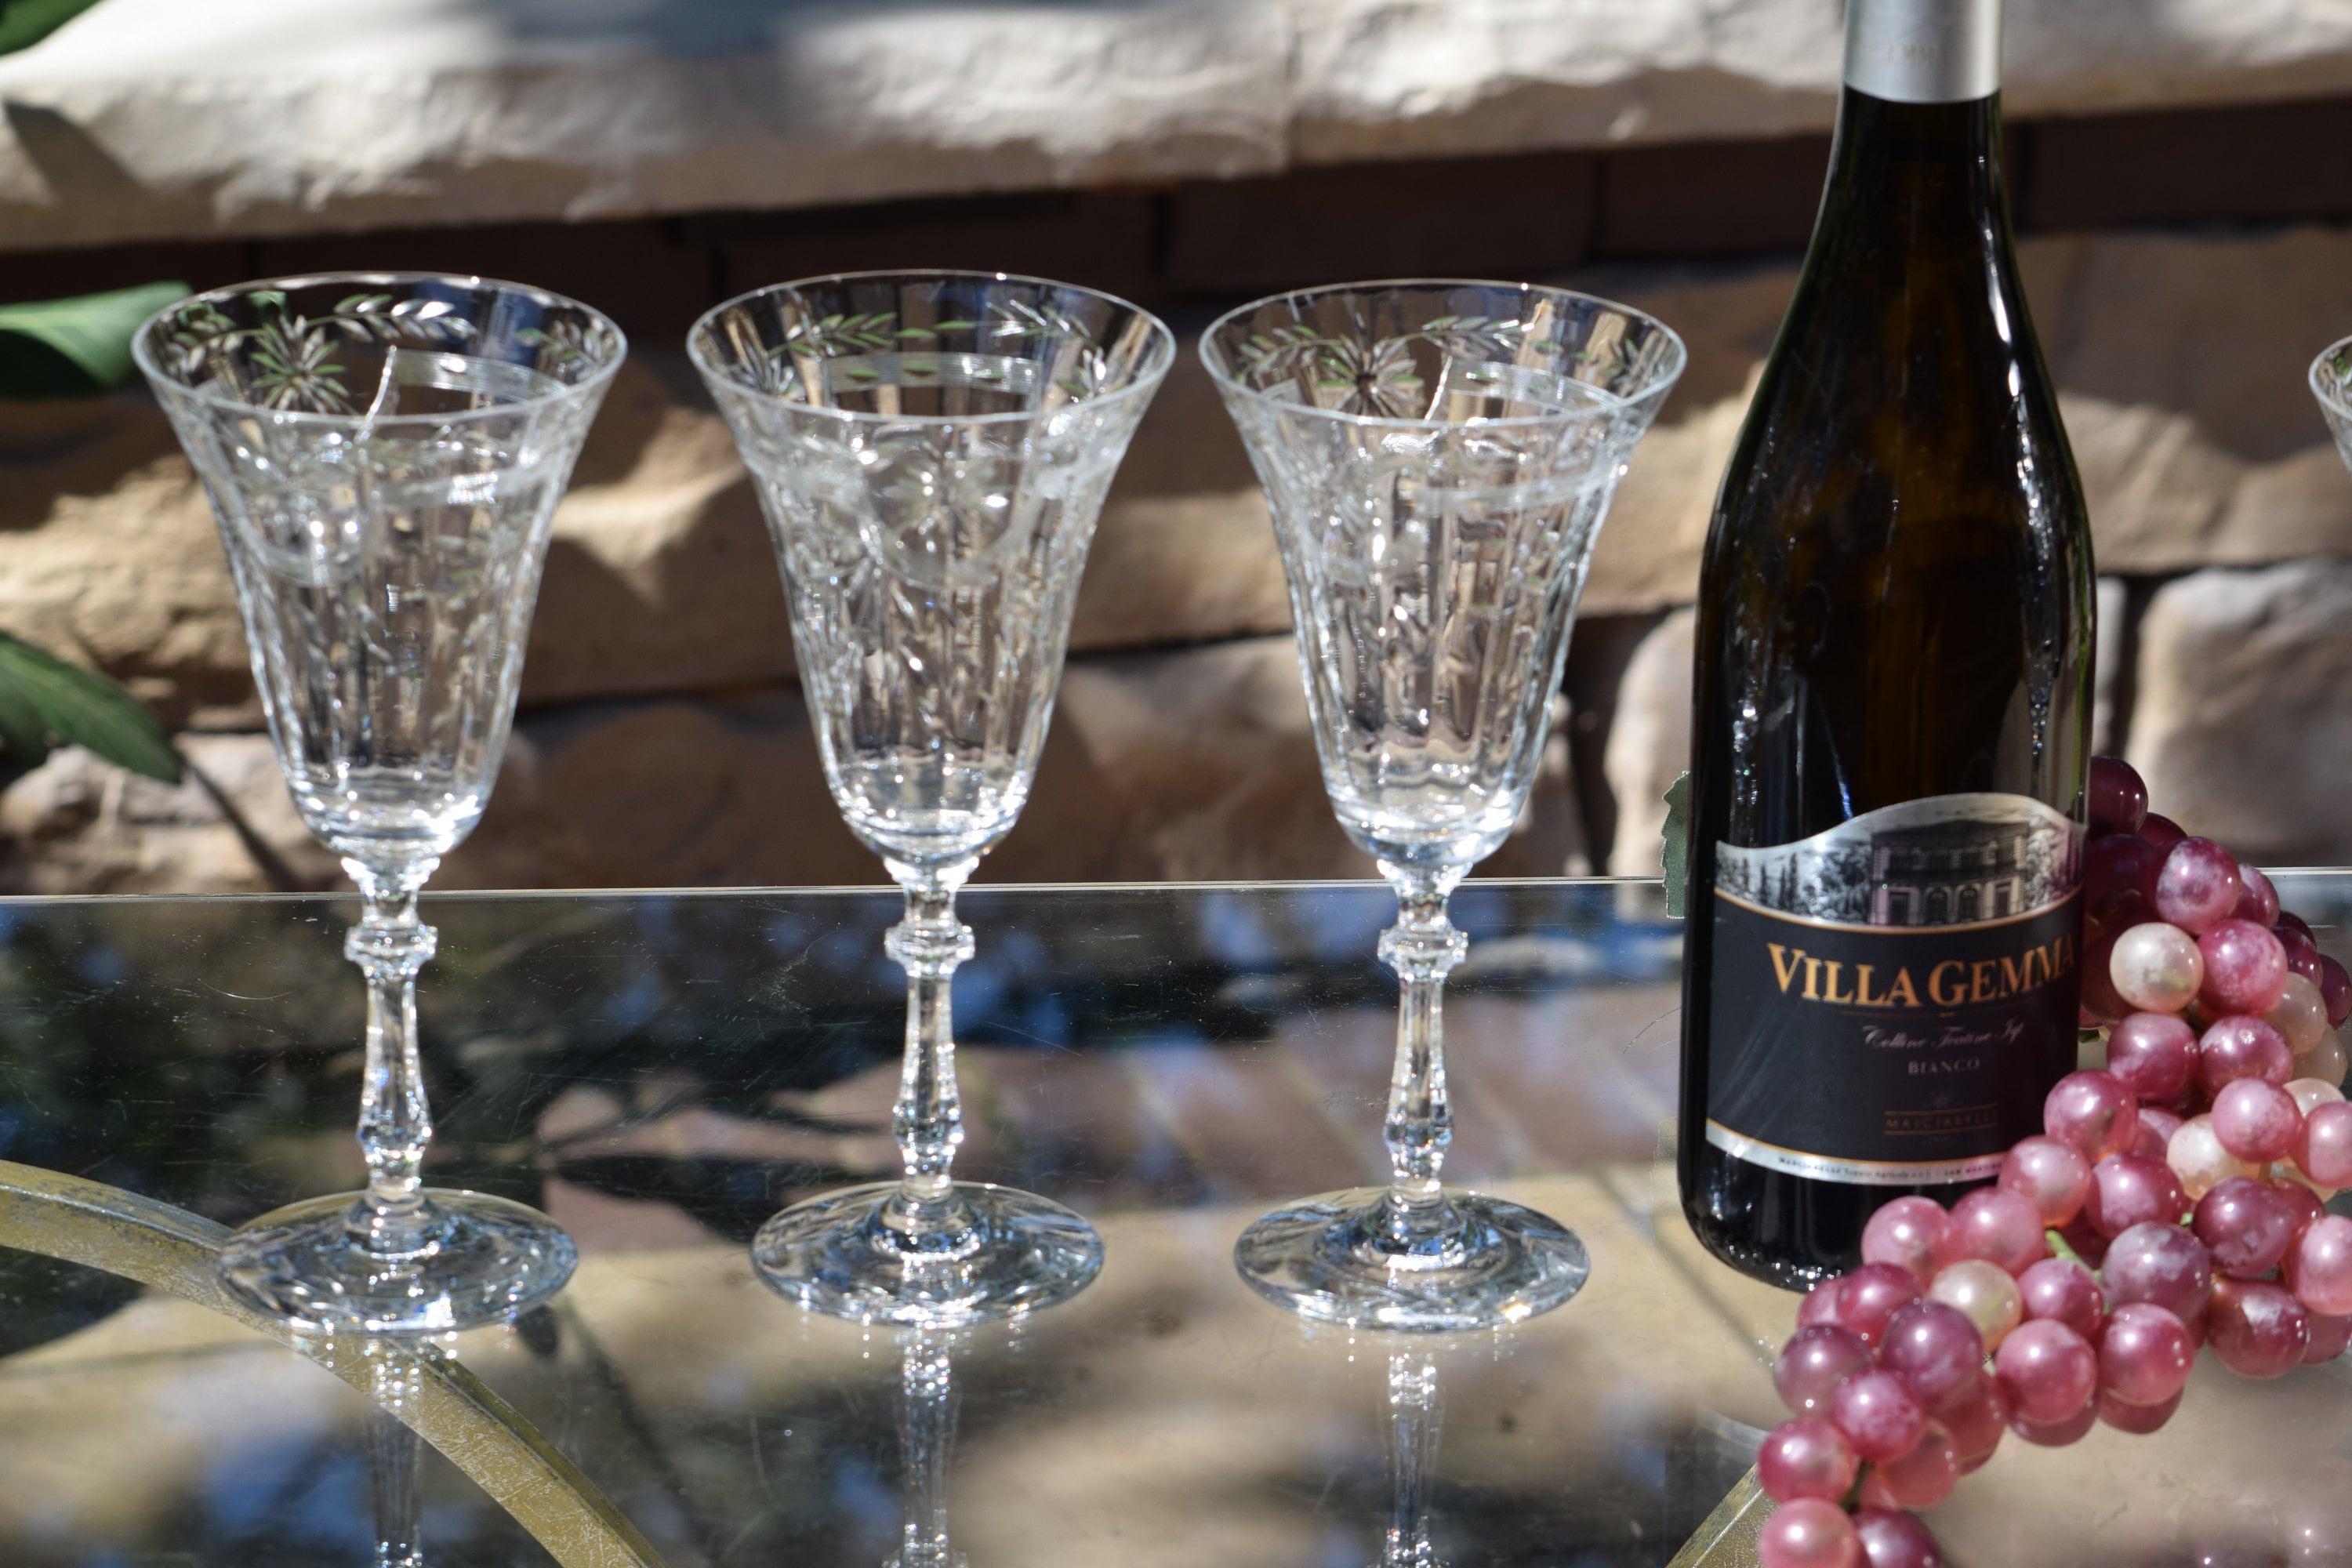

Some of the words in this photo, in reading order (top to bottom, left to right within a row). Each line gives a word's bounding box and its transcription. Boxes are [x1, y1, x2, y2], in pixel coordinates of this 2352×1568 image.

[1767, 942, 1922, 1007] VILLA
[1927, 932, 2075, 1007] GEMMA
[1907, 1057, 1981, 1076] BIANCO
